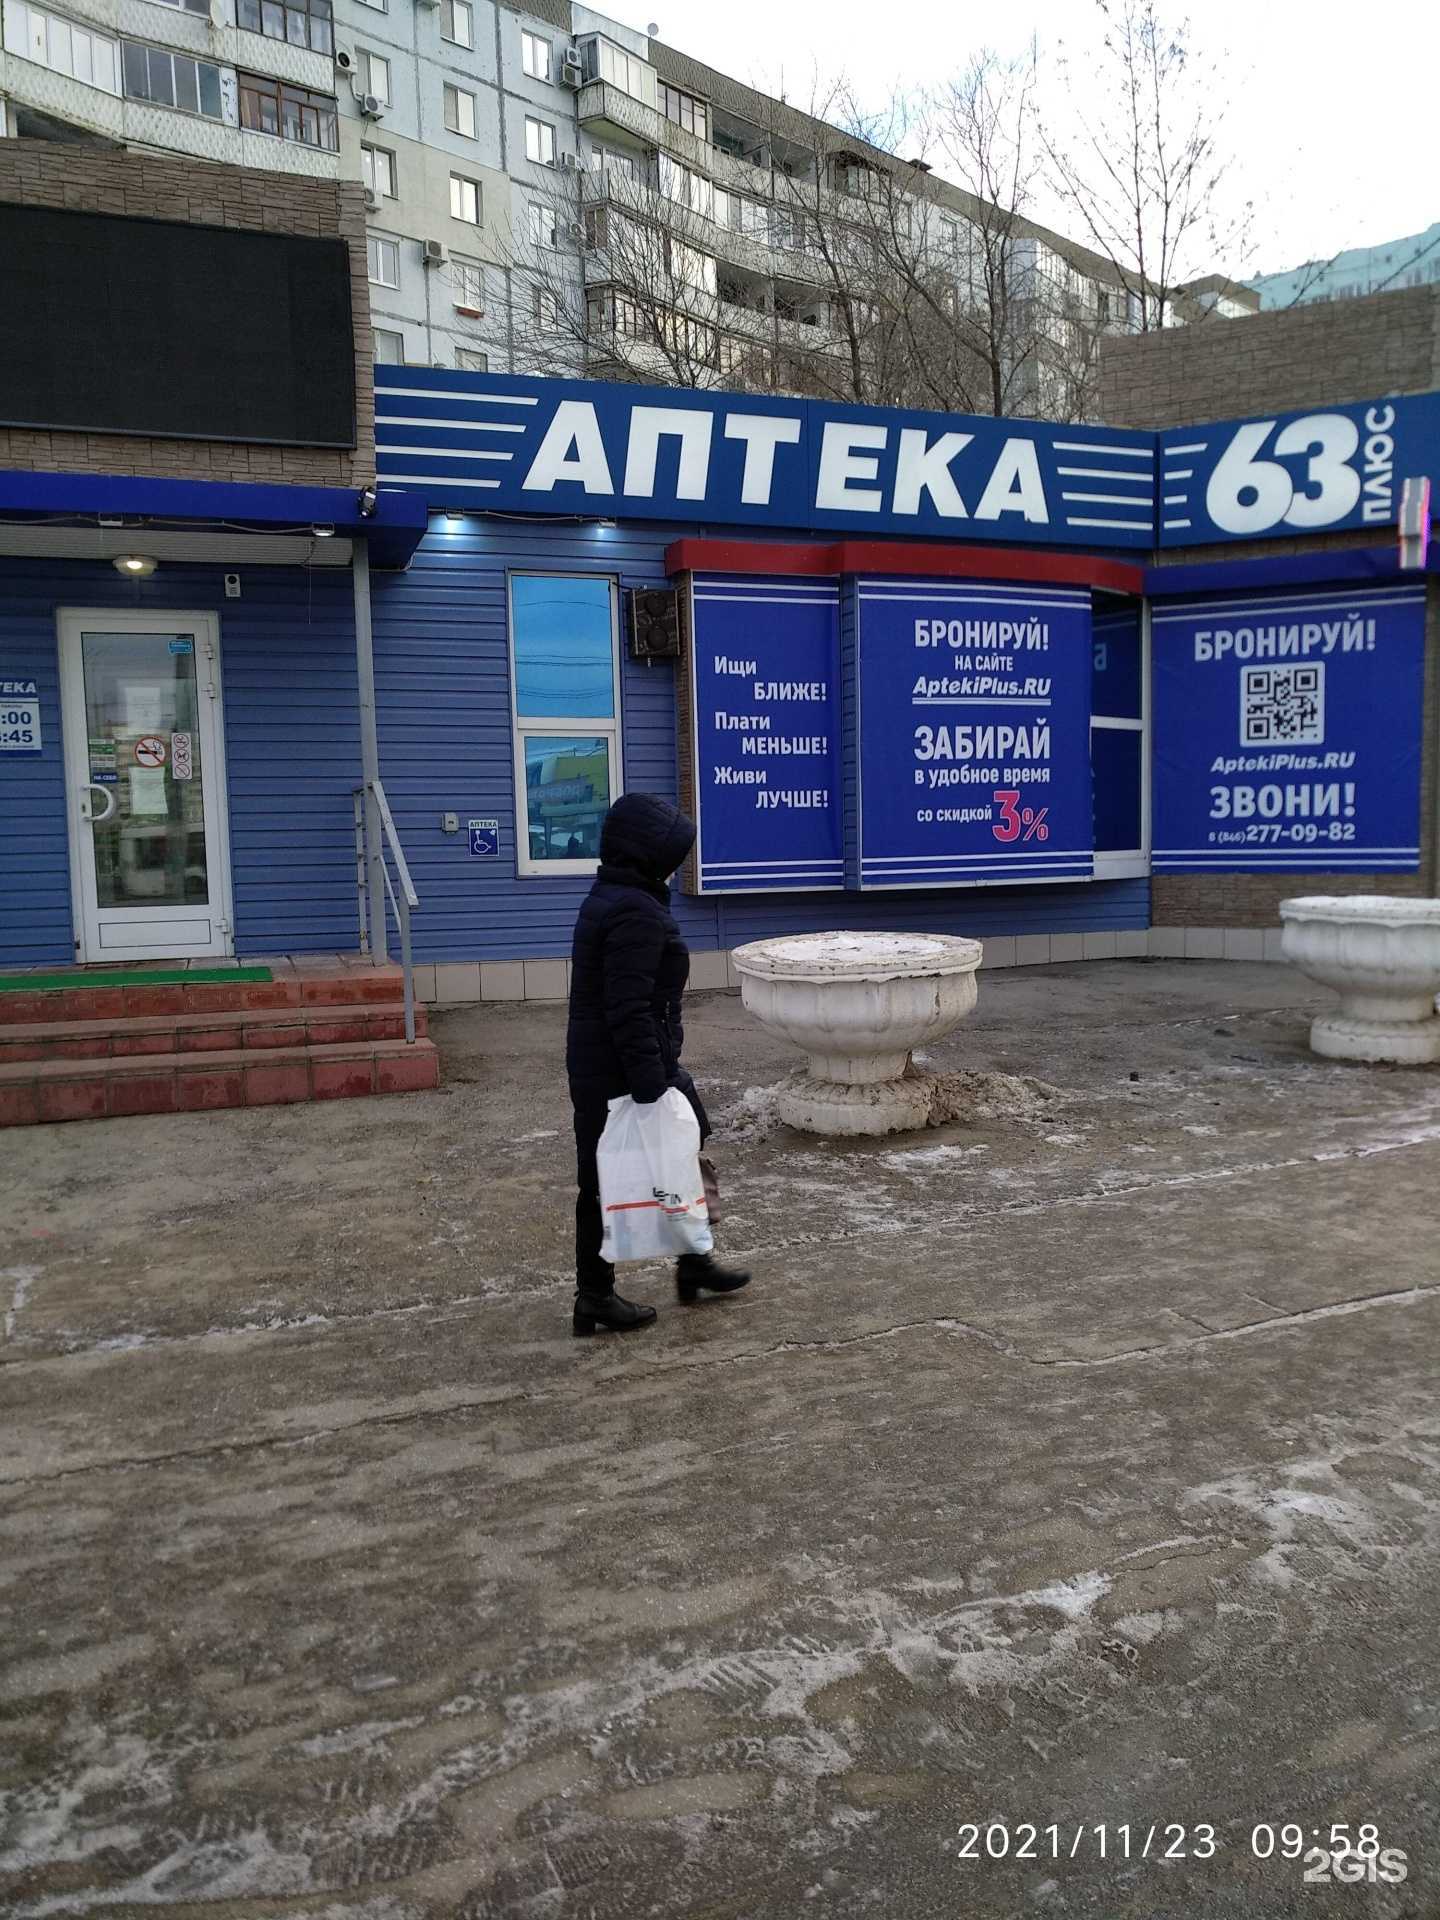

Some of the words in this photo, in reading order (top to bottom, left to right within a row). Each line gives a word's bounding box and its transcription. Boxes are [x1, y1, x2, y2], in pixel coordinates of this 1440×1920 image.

[521, 400, 1050, 523] АПТЕКА
[1363, 405, 1395, 521] ПЛЮС
[1206, 414, 1361, 534] 63
[914, 616, 1049, 651] БРОНИРУЙ!
[1194, 613, 1376, 662] БРОНИРУЙ!
[714, 655, 757, 678] Ищи
[954, 655, 973, 671] НА
[975, 653, 1013, 672] САЙТЕ
[754, 681, 826, 701] БЛИЖЕ!
[912, 675, 1052, 697] AptekiPlus.RU
[714, 711, 771, 730] Плати
[742, 736, 828, 755] МЕНЬШЕ!
[914, 717, 1050, 761] ЗАБИРАЙ
[1210, 752, 1356, 775] AptekiPlus.RU
[714, 766, 767, 785] Живи
[914, 769, 925, 785] в
[928, 764, 1000, 788] удобное
[1003, 767, 1050, 787] время
[755, 790, 829, 809] ЛУЧШЕ!
[1209, 782, 1356, 819] ЗВОНИ!
[916, 809, 933, 822] со
[936, 805, 991, 823] скидкой
[992, 790, 1049, 842] 3%
